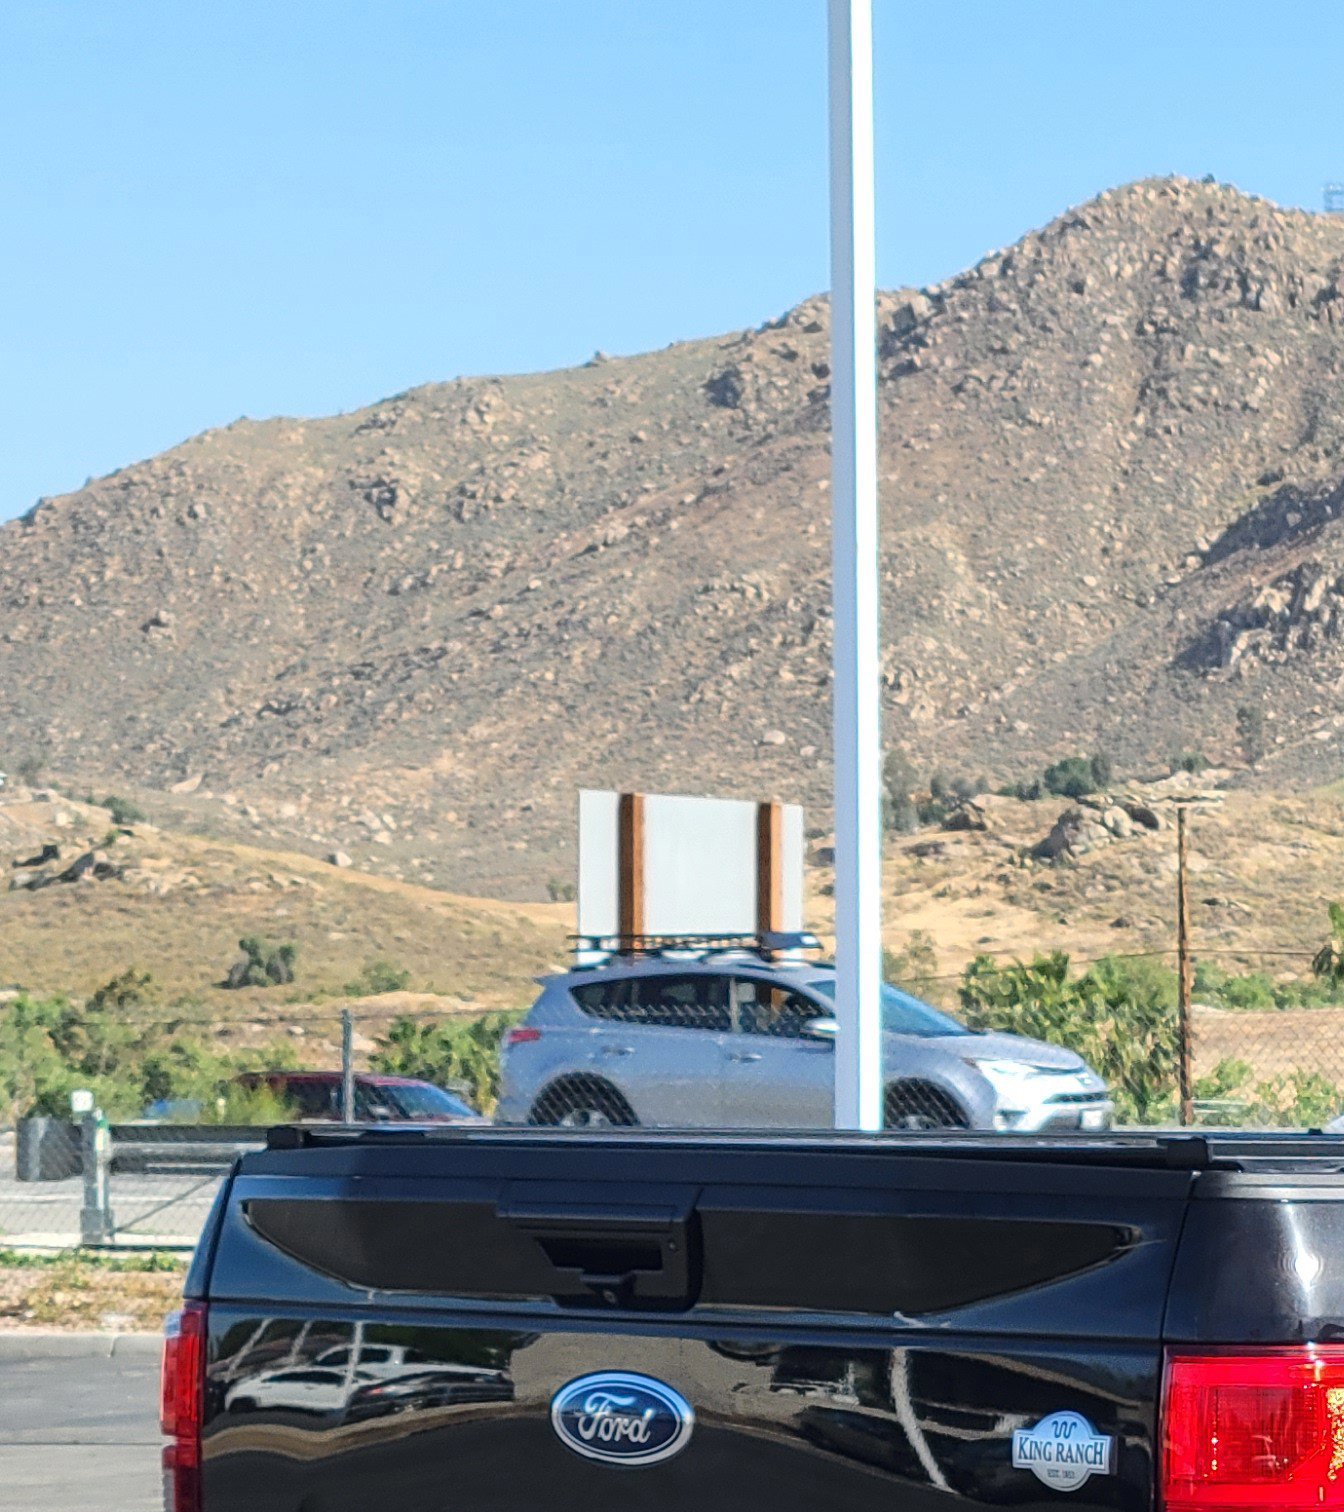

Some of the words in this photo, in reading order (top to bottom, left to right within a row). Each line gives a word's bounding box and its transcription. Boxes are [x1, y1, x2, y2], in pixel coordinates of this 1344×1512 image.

[577, 1391, 654, 1446] Ford
[1018, 1436, 1053, 1462] KING
[1055, 1441, 1104, 1465] RANCH
